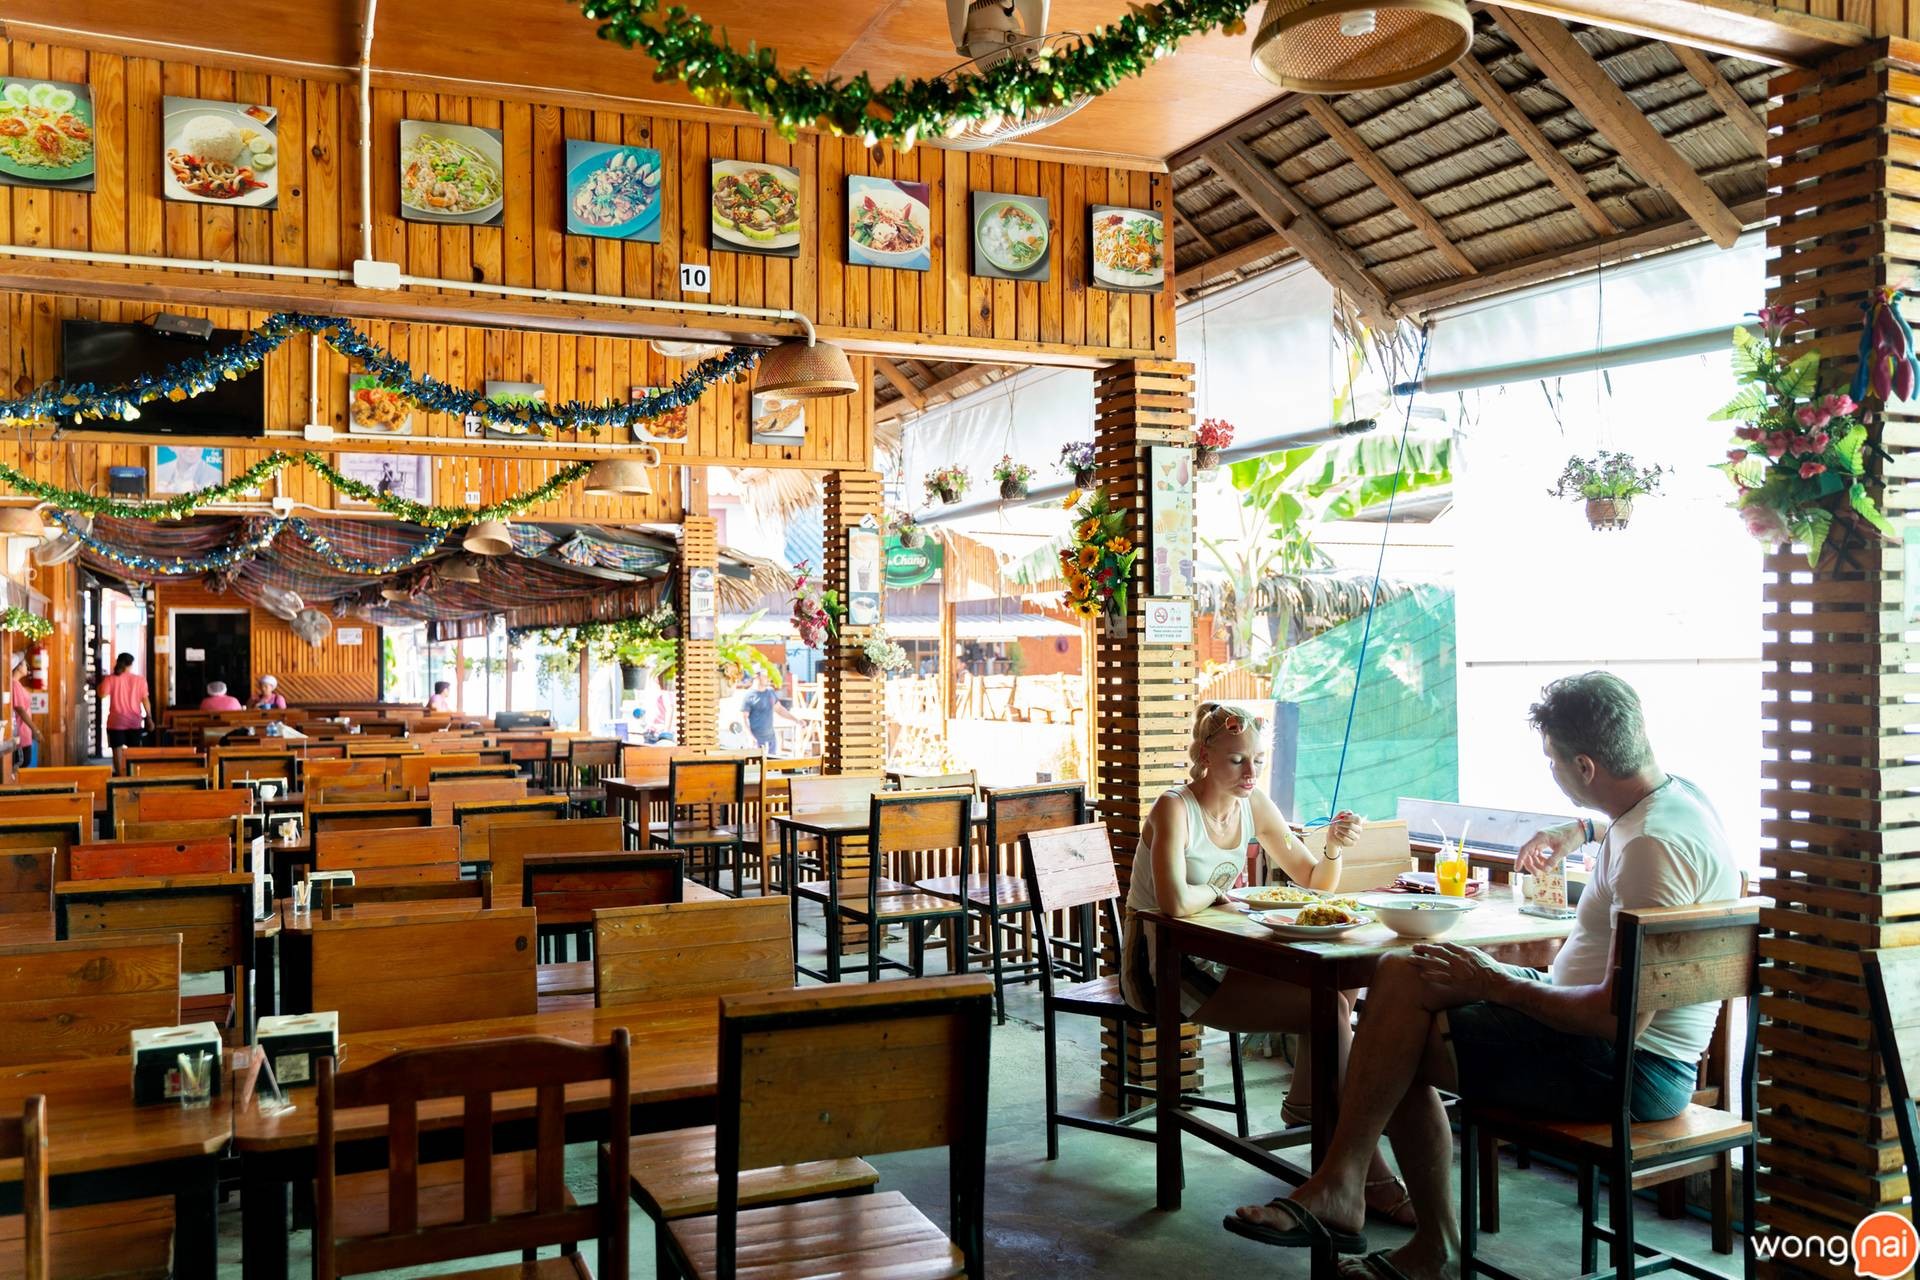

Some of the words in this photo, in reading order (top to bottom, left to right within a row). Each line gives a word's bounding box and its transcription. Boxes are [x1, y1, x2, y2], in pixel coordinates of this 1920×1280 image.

[682, 268, 706, 286] 10
[467, 421, 482, 432] 12
[893, 553, 926, 567] Chang
